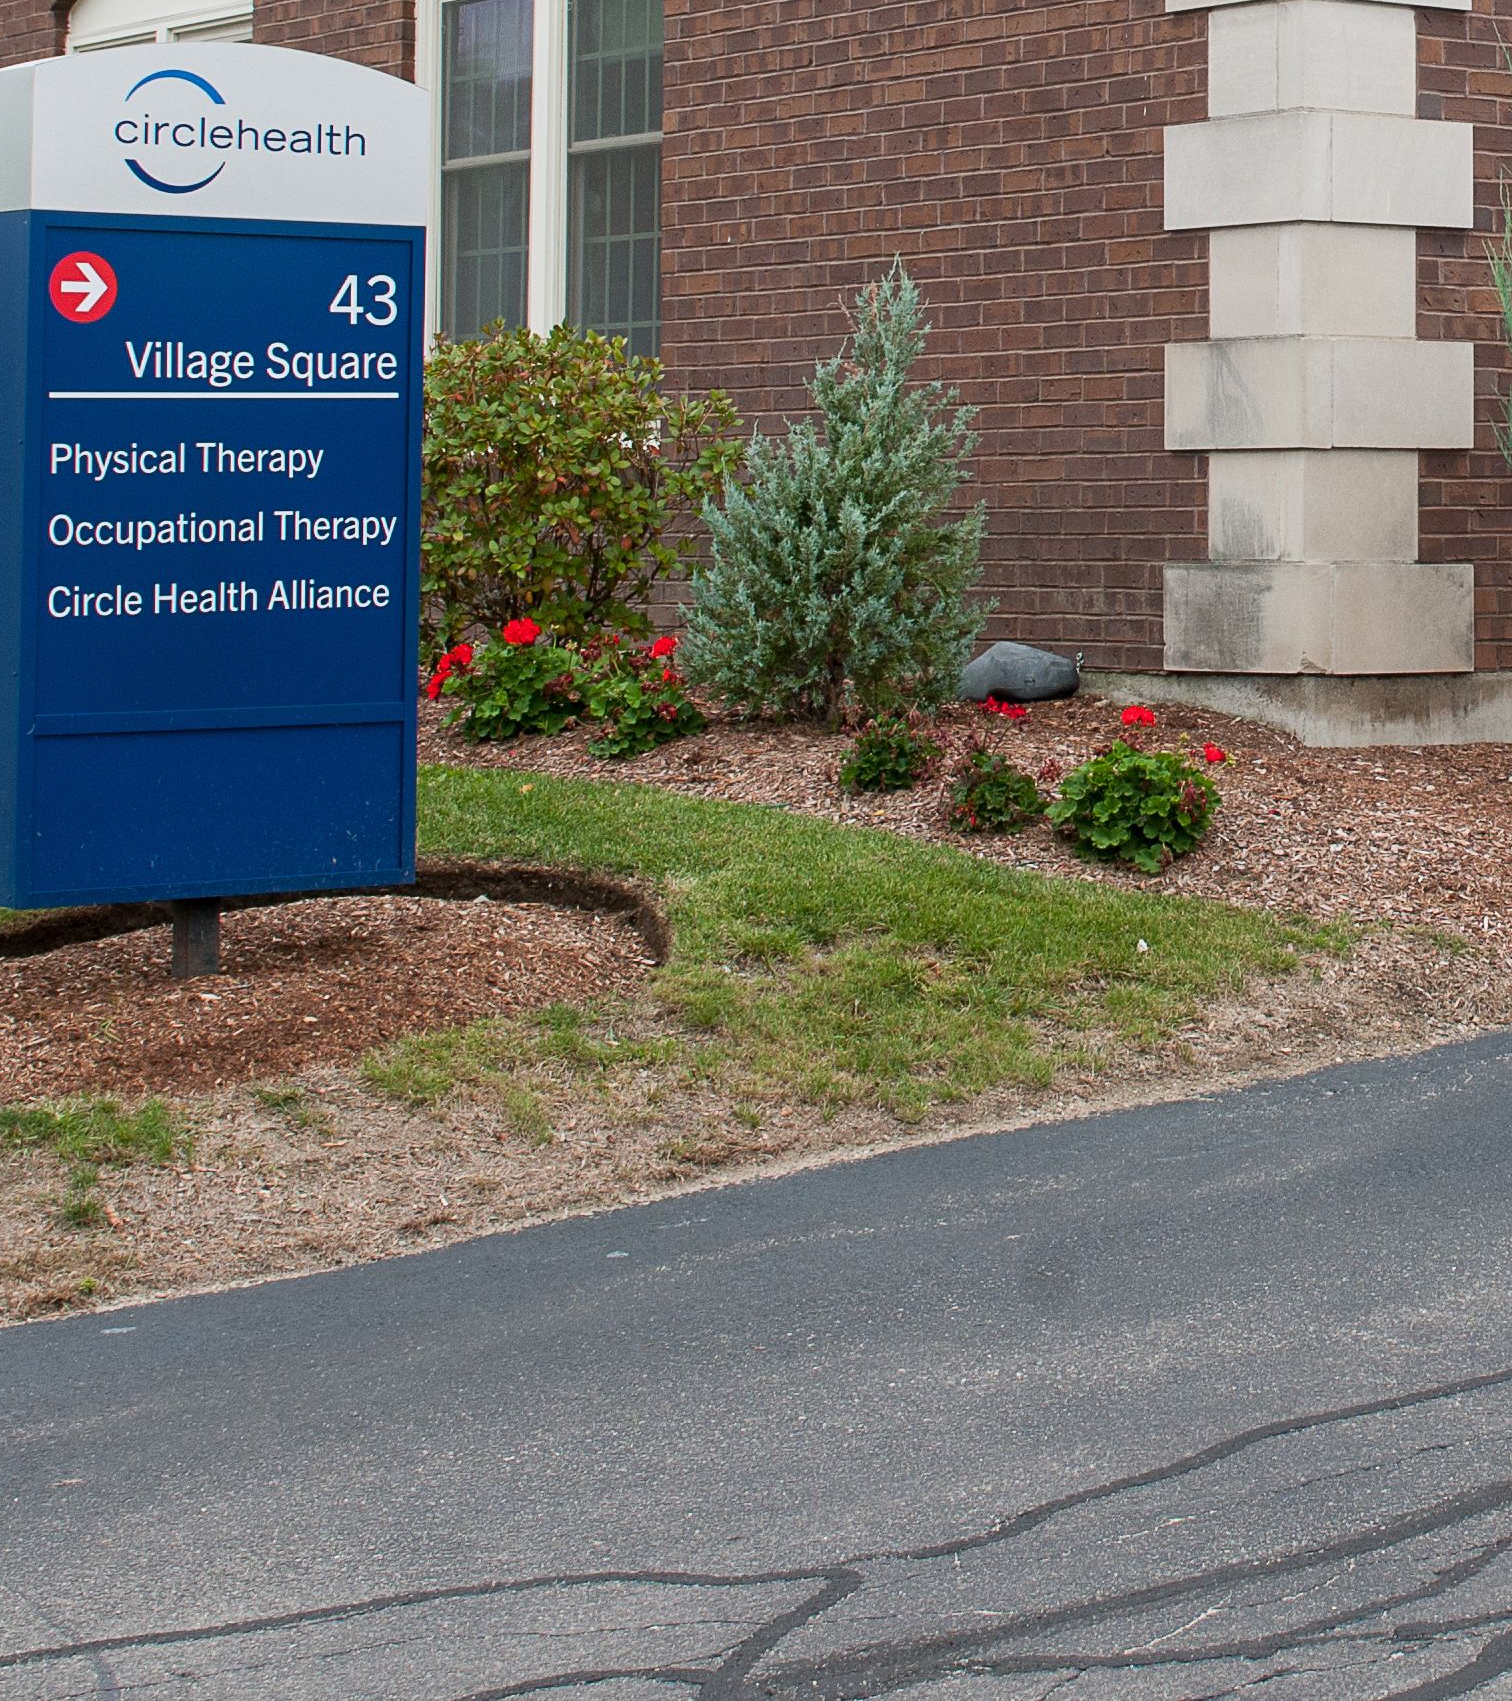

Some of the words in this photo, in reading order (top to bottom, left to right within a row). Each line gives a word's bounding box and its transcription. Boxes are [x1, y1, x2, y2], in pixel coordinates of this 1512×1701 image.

[114, 113, 366, 156] circlehealth
[329, 274, 398, 326] 43
[125, 341, 255, 388] Village
[266, 342, 398, 387] Square
[50, 443, 186, 481] Physical
[196, 443, 324, 479] Therapy
[48, 512, 264, 551] Occupational
[273, 511, 397, 546] Therapy
[48, 585, 143, 618] Circle
[153, 582, 258, 615] Health
[268, 579, 390, 611] Alliance
